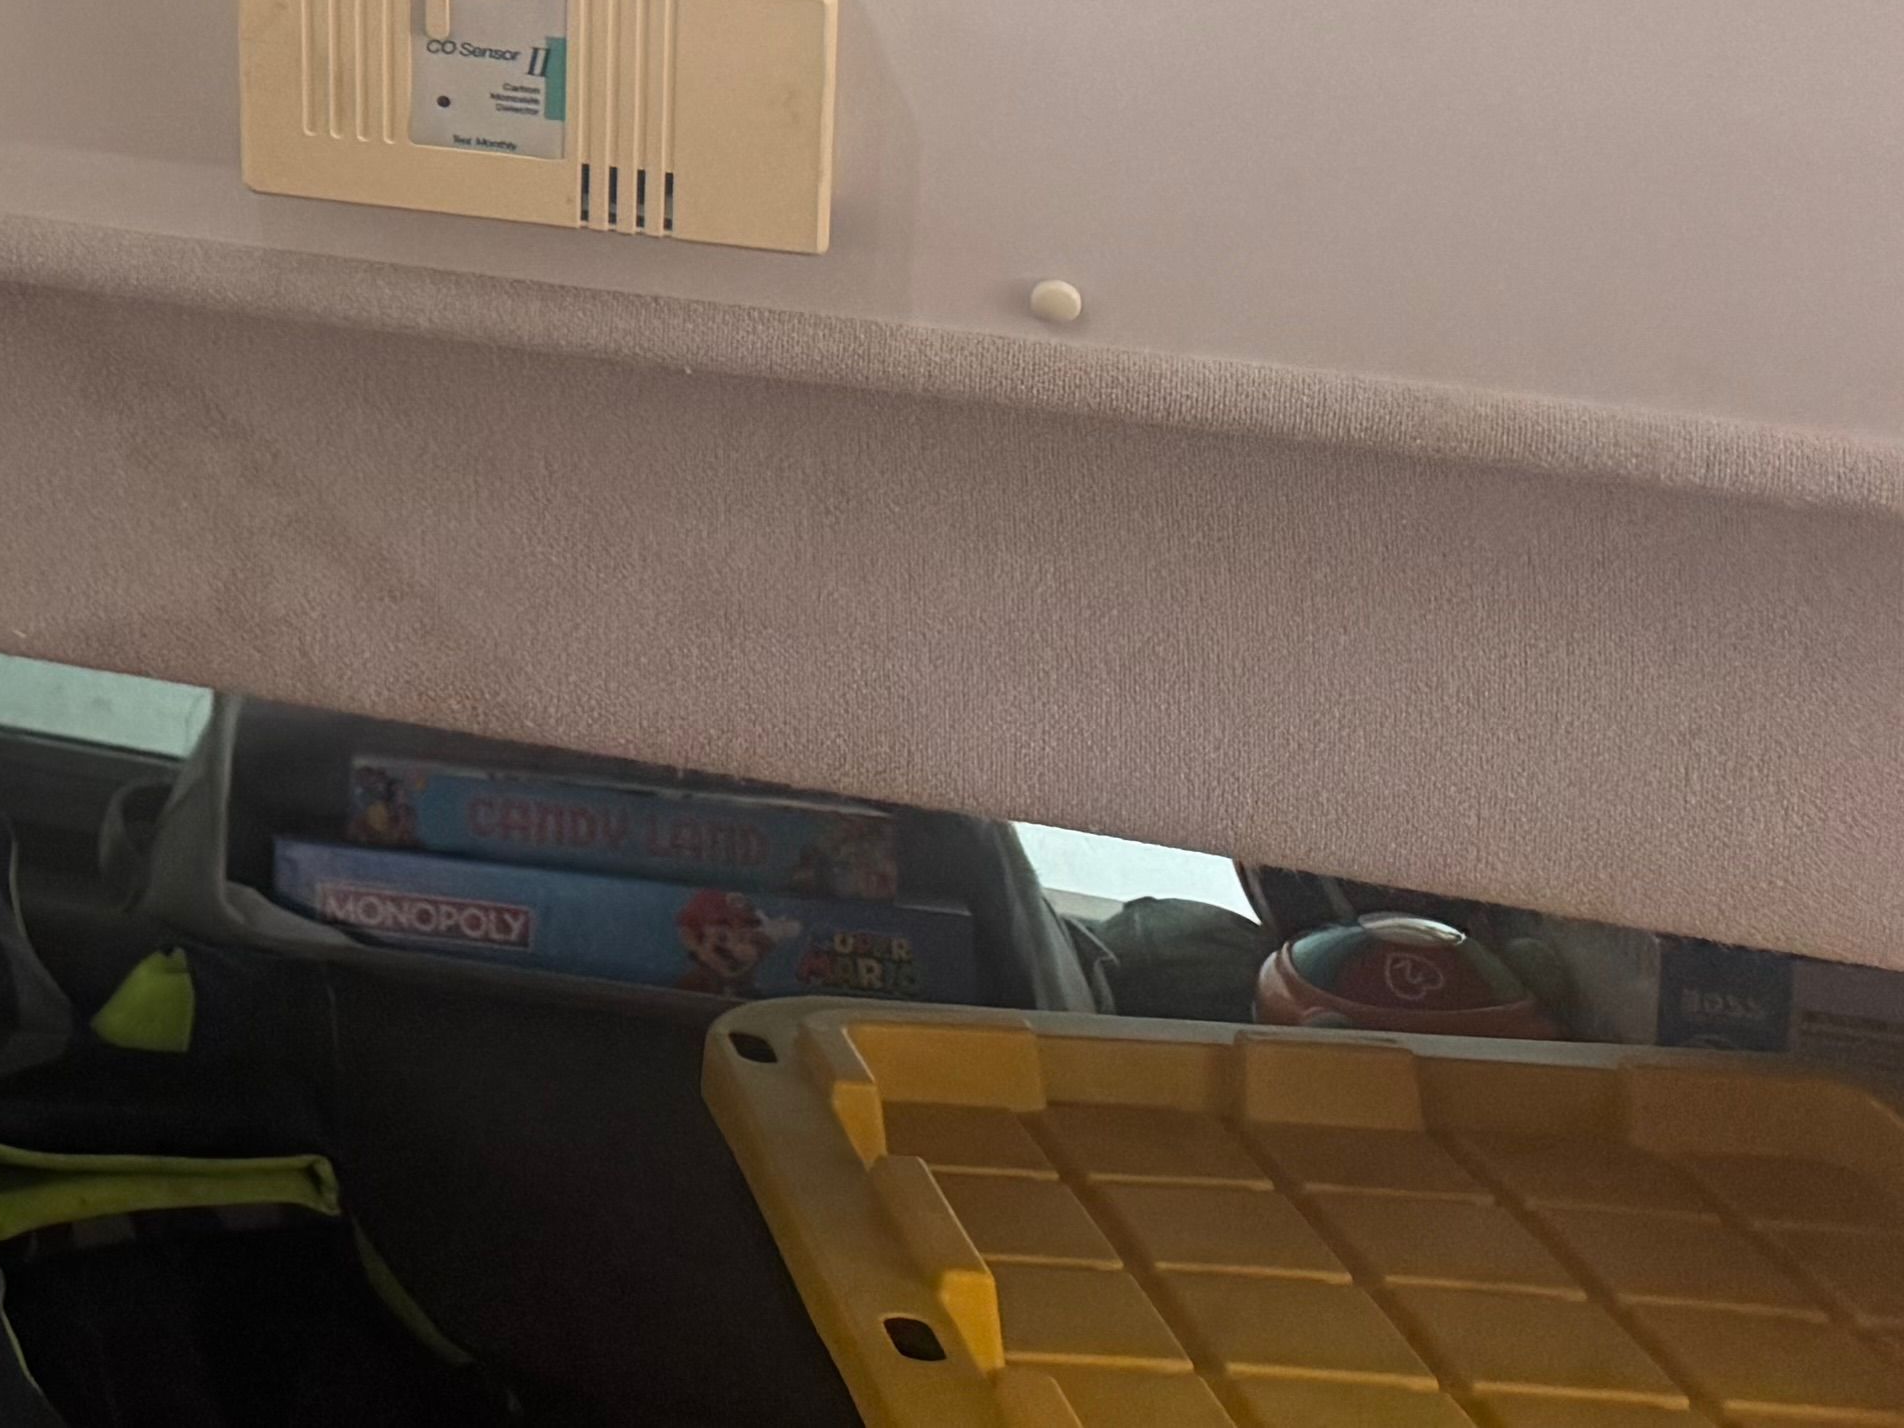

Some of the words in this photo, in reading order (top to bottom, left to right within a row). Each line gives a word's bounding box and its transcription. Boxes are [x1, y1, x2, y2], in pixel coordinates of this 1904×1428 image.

[426, 39, 457, 55] CO
[459, 41, 522, 61] Sensor
[467, 795, 630, 850] CANDY
[644, 813, 769, 864] LAND
[323, 894, 527, 941] MONOPOLY
